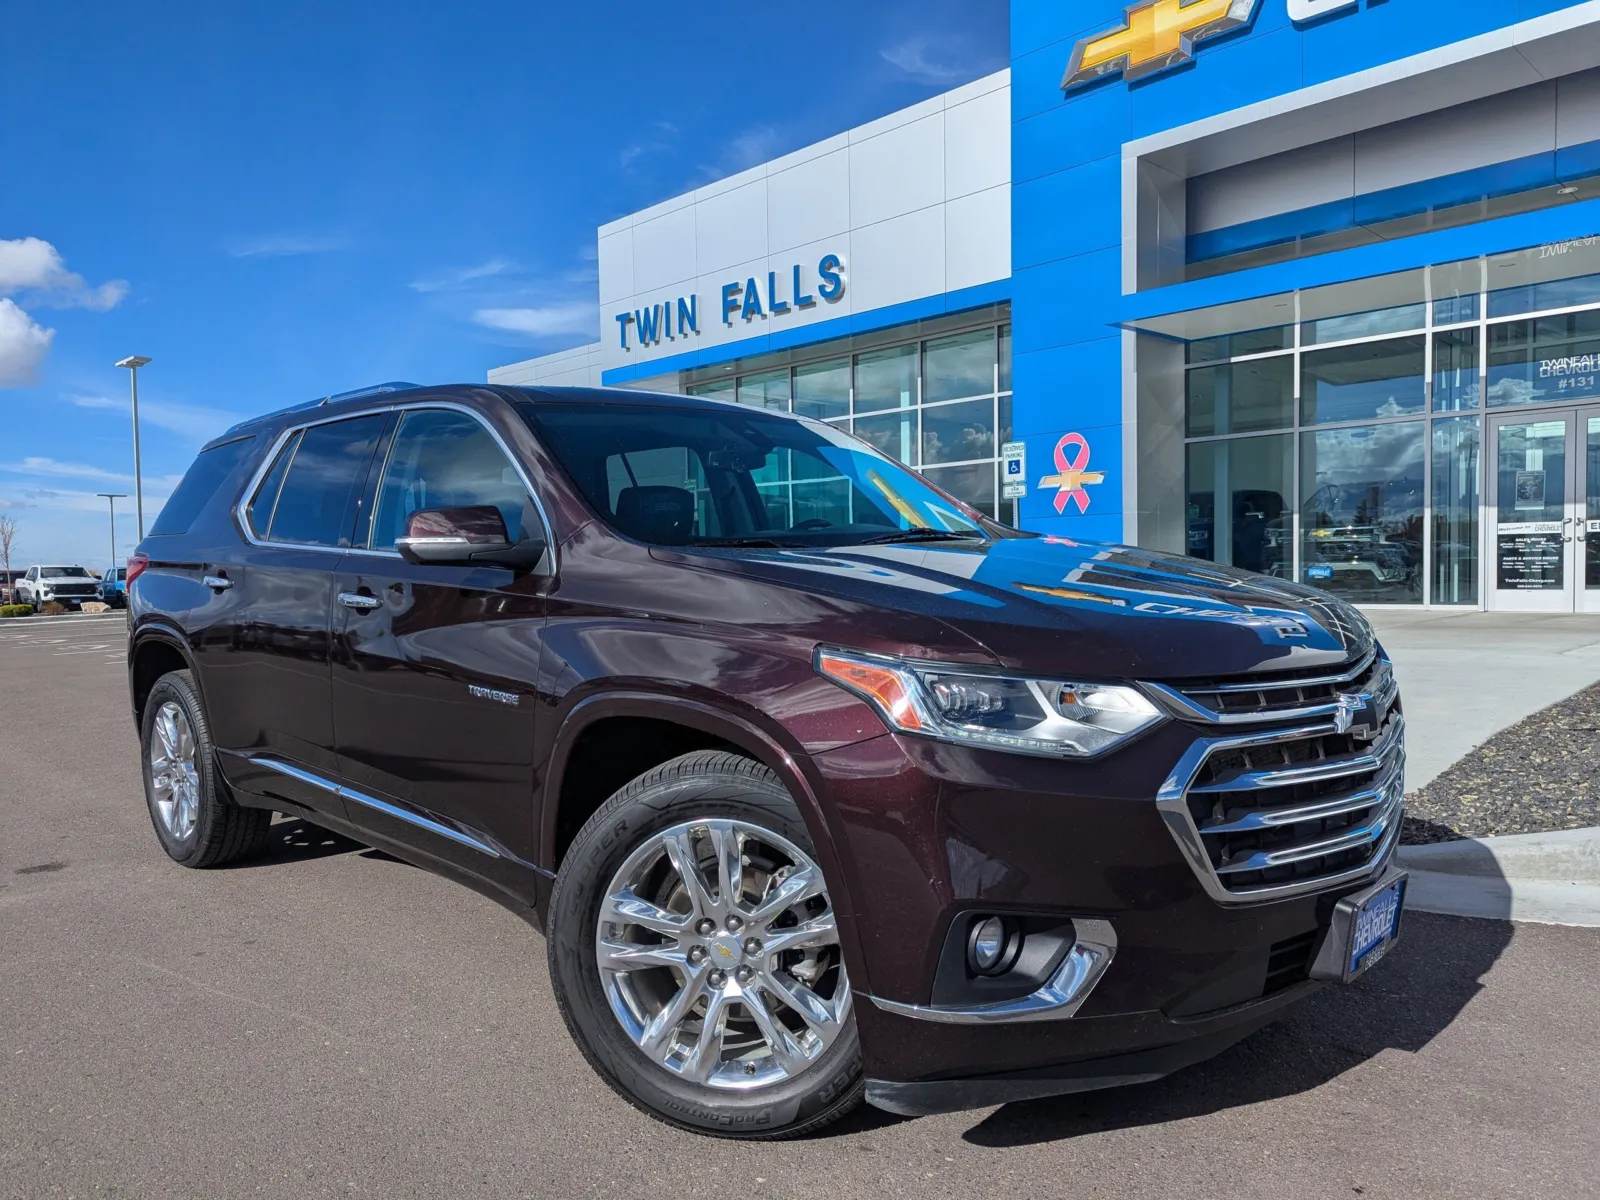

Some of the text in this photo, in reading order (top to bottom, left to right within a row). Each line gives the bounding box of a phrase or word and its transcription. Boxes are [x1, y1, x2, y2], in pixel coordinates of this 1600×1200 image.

[615, 254, 845, 350] TWIN FALLS
[1558, 375, 1595, 389] #131
[467, 684, 520, 706] TRAVERSE
[1352, 903, 1398, 956] CHEVROLET
[819, 1054, 863, 1104] PER
